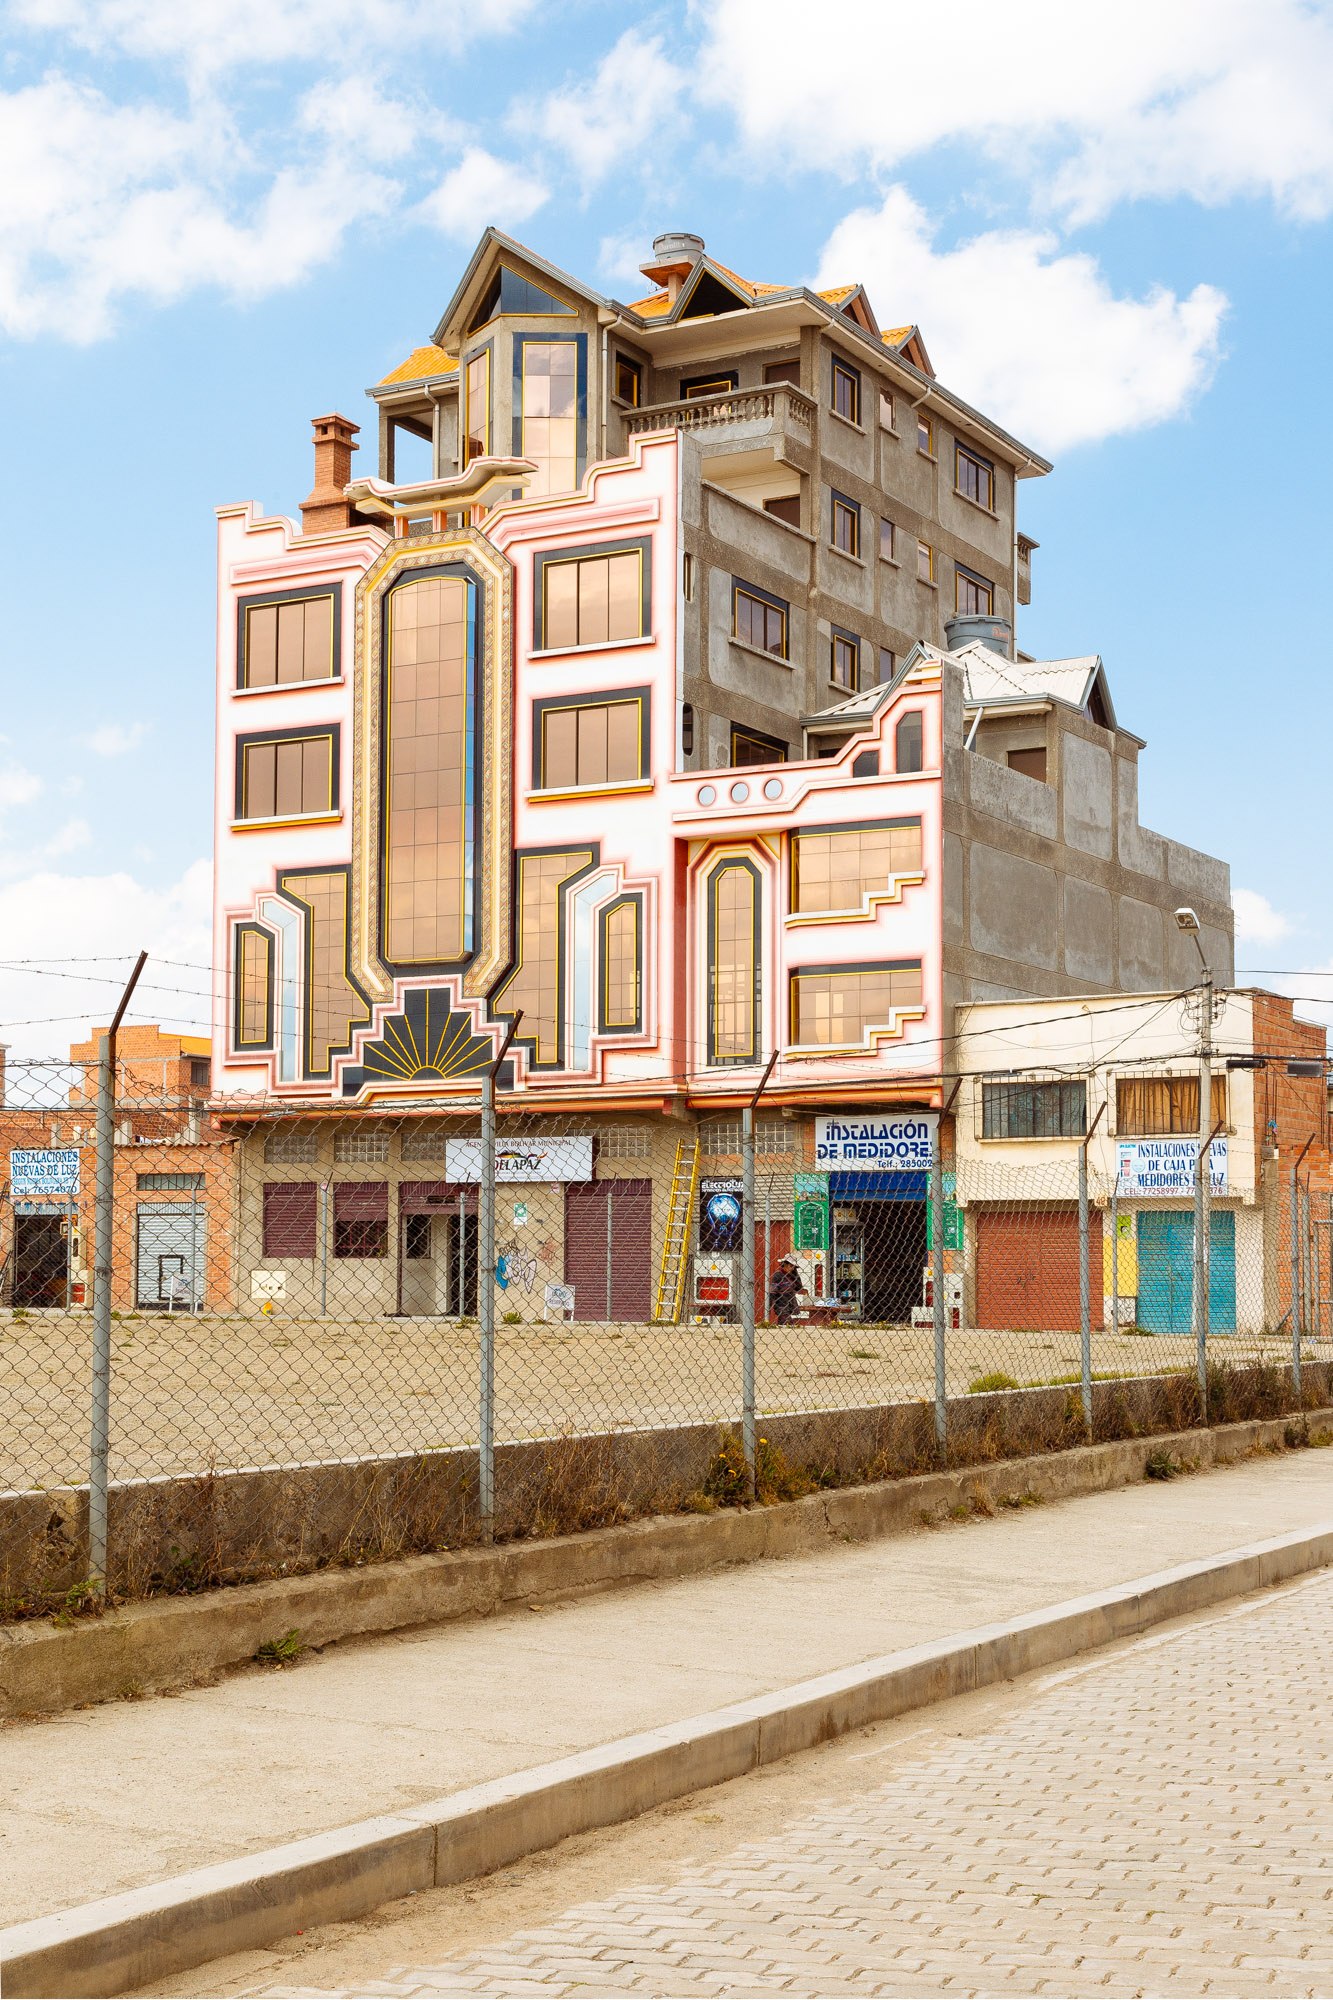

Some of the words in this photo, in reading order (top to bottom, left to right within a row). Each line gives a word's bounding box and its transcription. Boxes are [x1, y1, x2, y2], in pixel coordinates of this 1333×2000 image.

[817, 1143, 838, 1159] DE
[843, 1141, 932, 1158] MEDIDORE
[1138, 1142, 1196, 1158] INSTALACIONES
[12, 1151, 78, 1164] INSTALACIONES
[12, 1165, 45, 1176] NUEVAS
[47, 1165, 59, 1176] DE
[61, 1164, 77, 1175] LUZ
[1148, 1160, 1160, 1171] DE
[1164, 1159, 1186, 1171] CAJA
[1137, 1173, 1190, 1187] MEDIDORES
